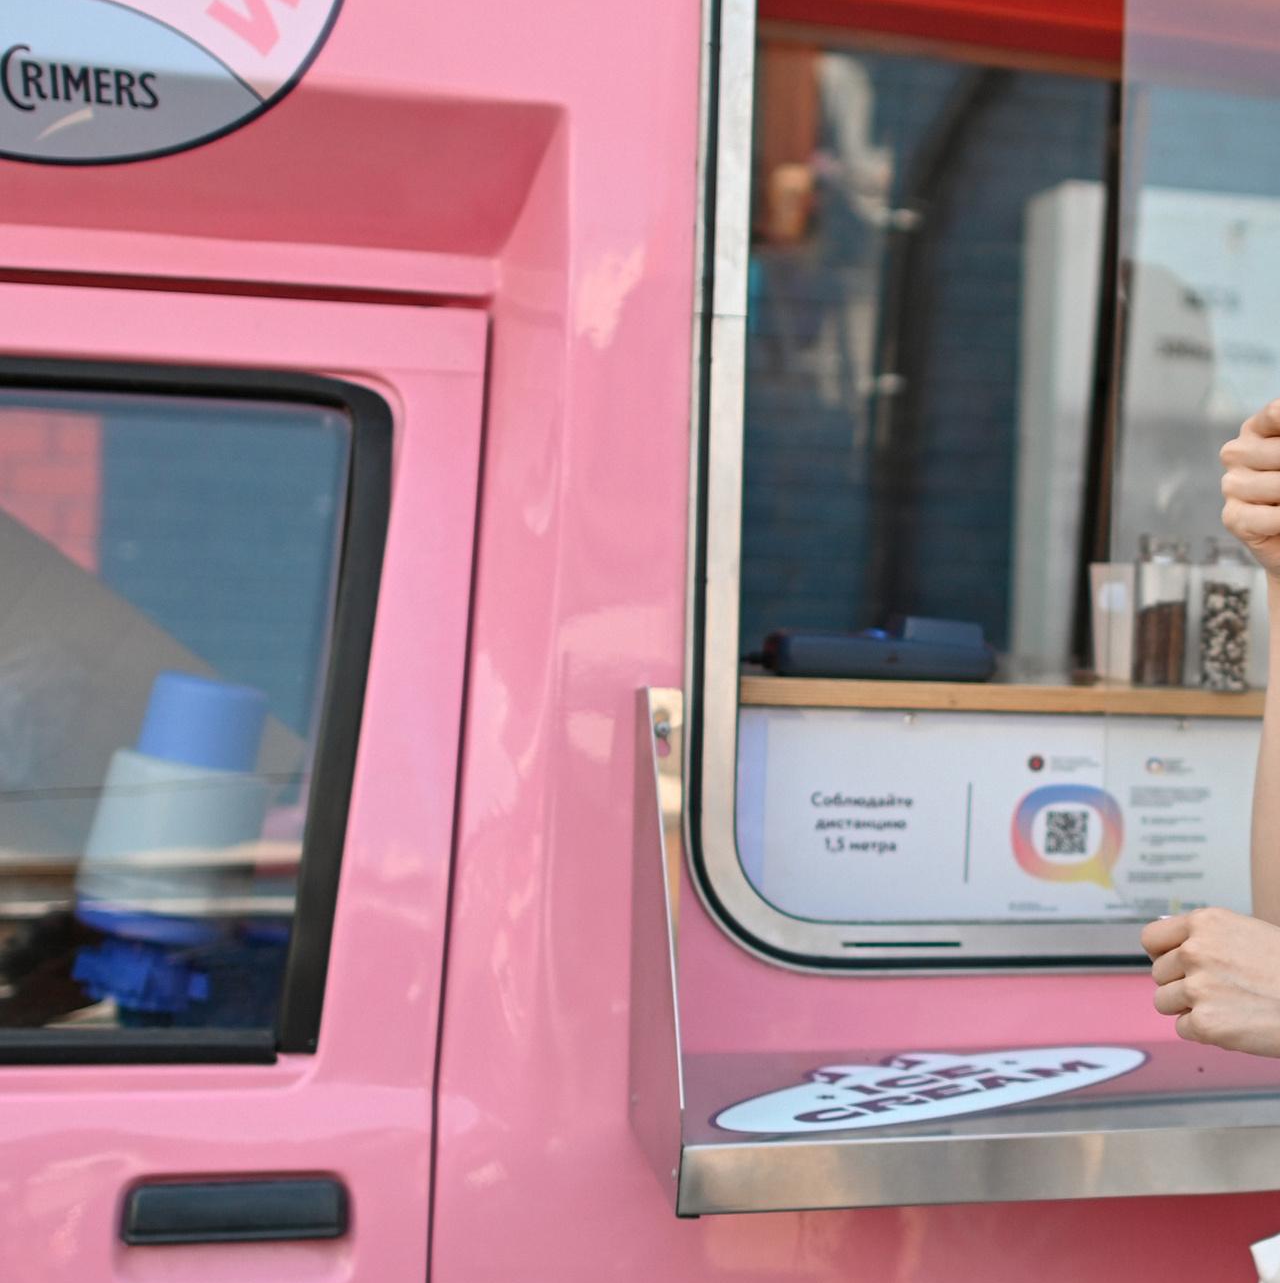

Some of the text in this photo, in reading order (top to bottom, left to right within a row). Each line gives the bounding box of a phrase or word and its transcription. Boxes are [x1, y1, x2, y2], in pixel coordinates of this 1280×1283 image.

[810, 790, 914, 808] Соблюдайте
[815, 817, 907, 831] дистанцию
[849, 841, 897, 854] метра
[851, 1063, 989, 1096] ICE
[793, 1058, 1108, 1123] CREAM
